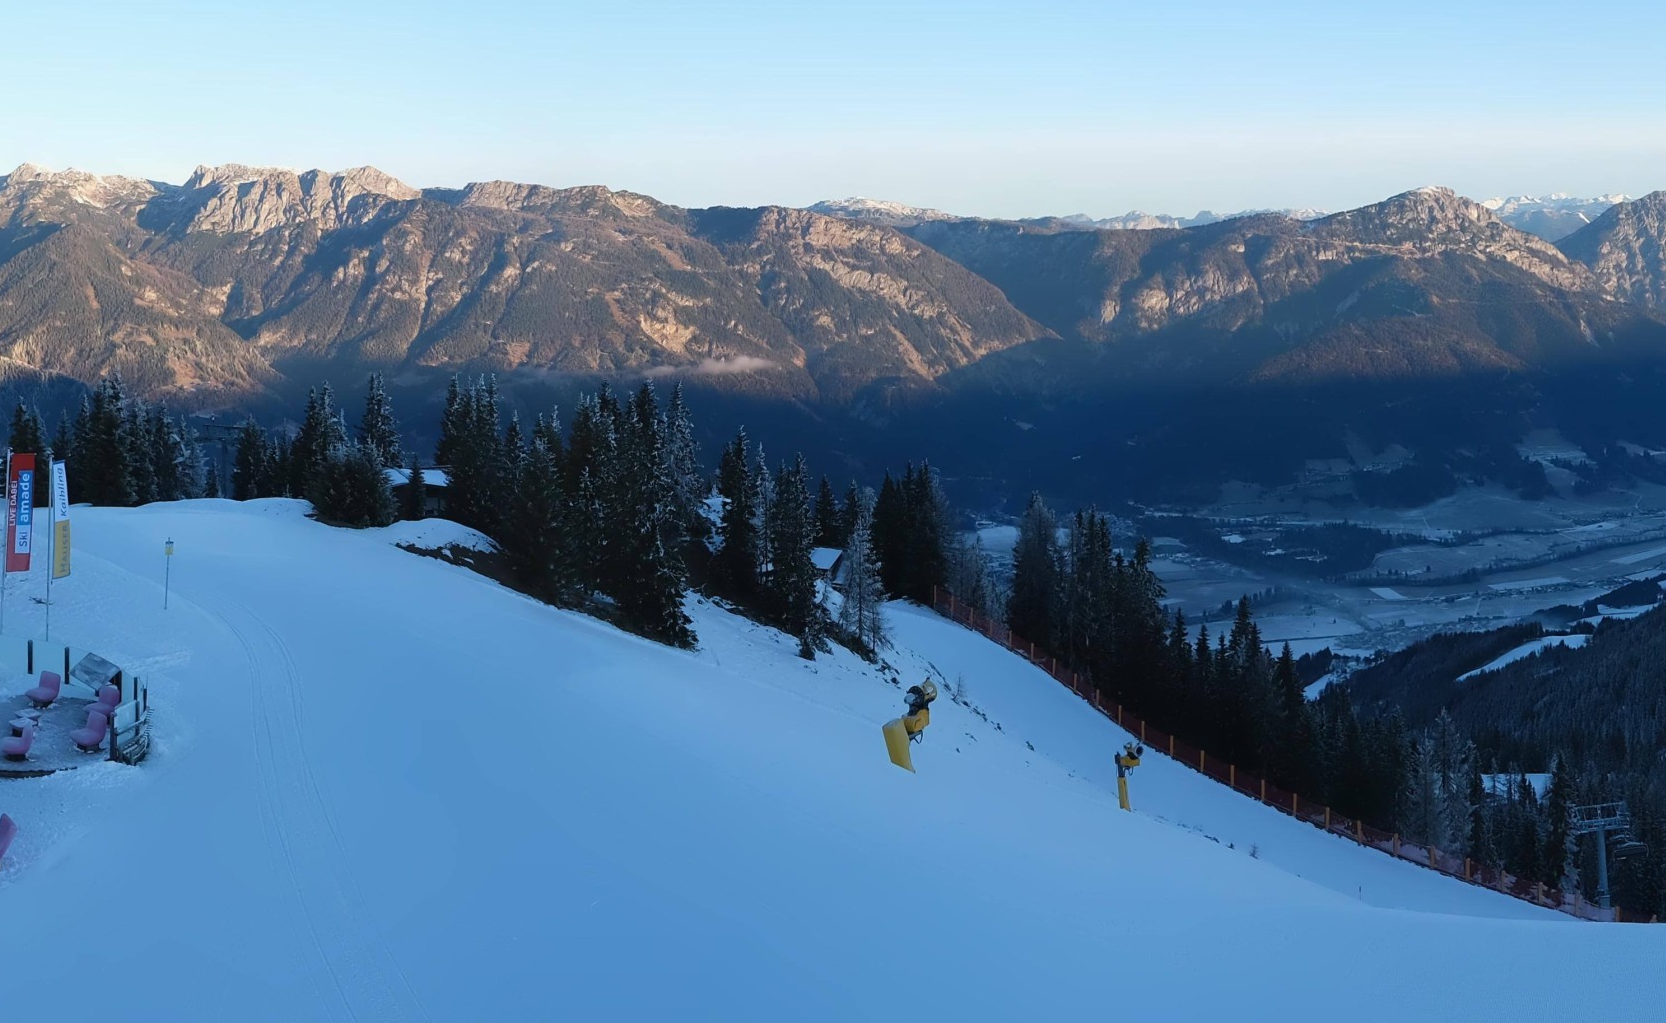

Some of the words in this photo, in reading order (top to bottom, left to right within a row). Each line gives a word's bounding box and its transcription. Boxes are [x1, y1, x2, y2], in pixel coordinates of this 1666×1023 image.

[10, 480, 18, 506] DABEI
[18, 473, 30, 523] amadé
[56, 467, 67, 517] Kaibling
[9, 507, 17, 526] LIVE
[19, 531, 28, 547] Ski
